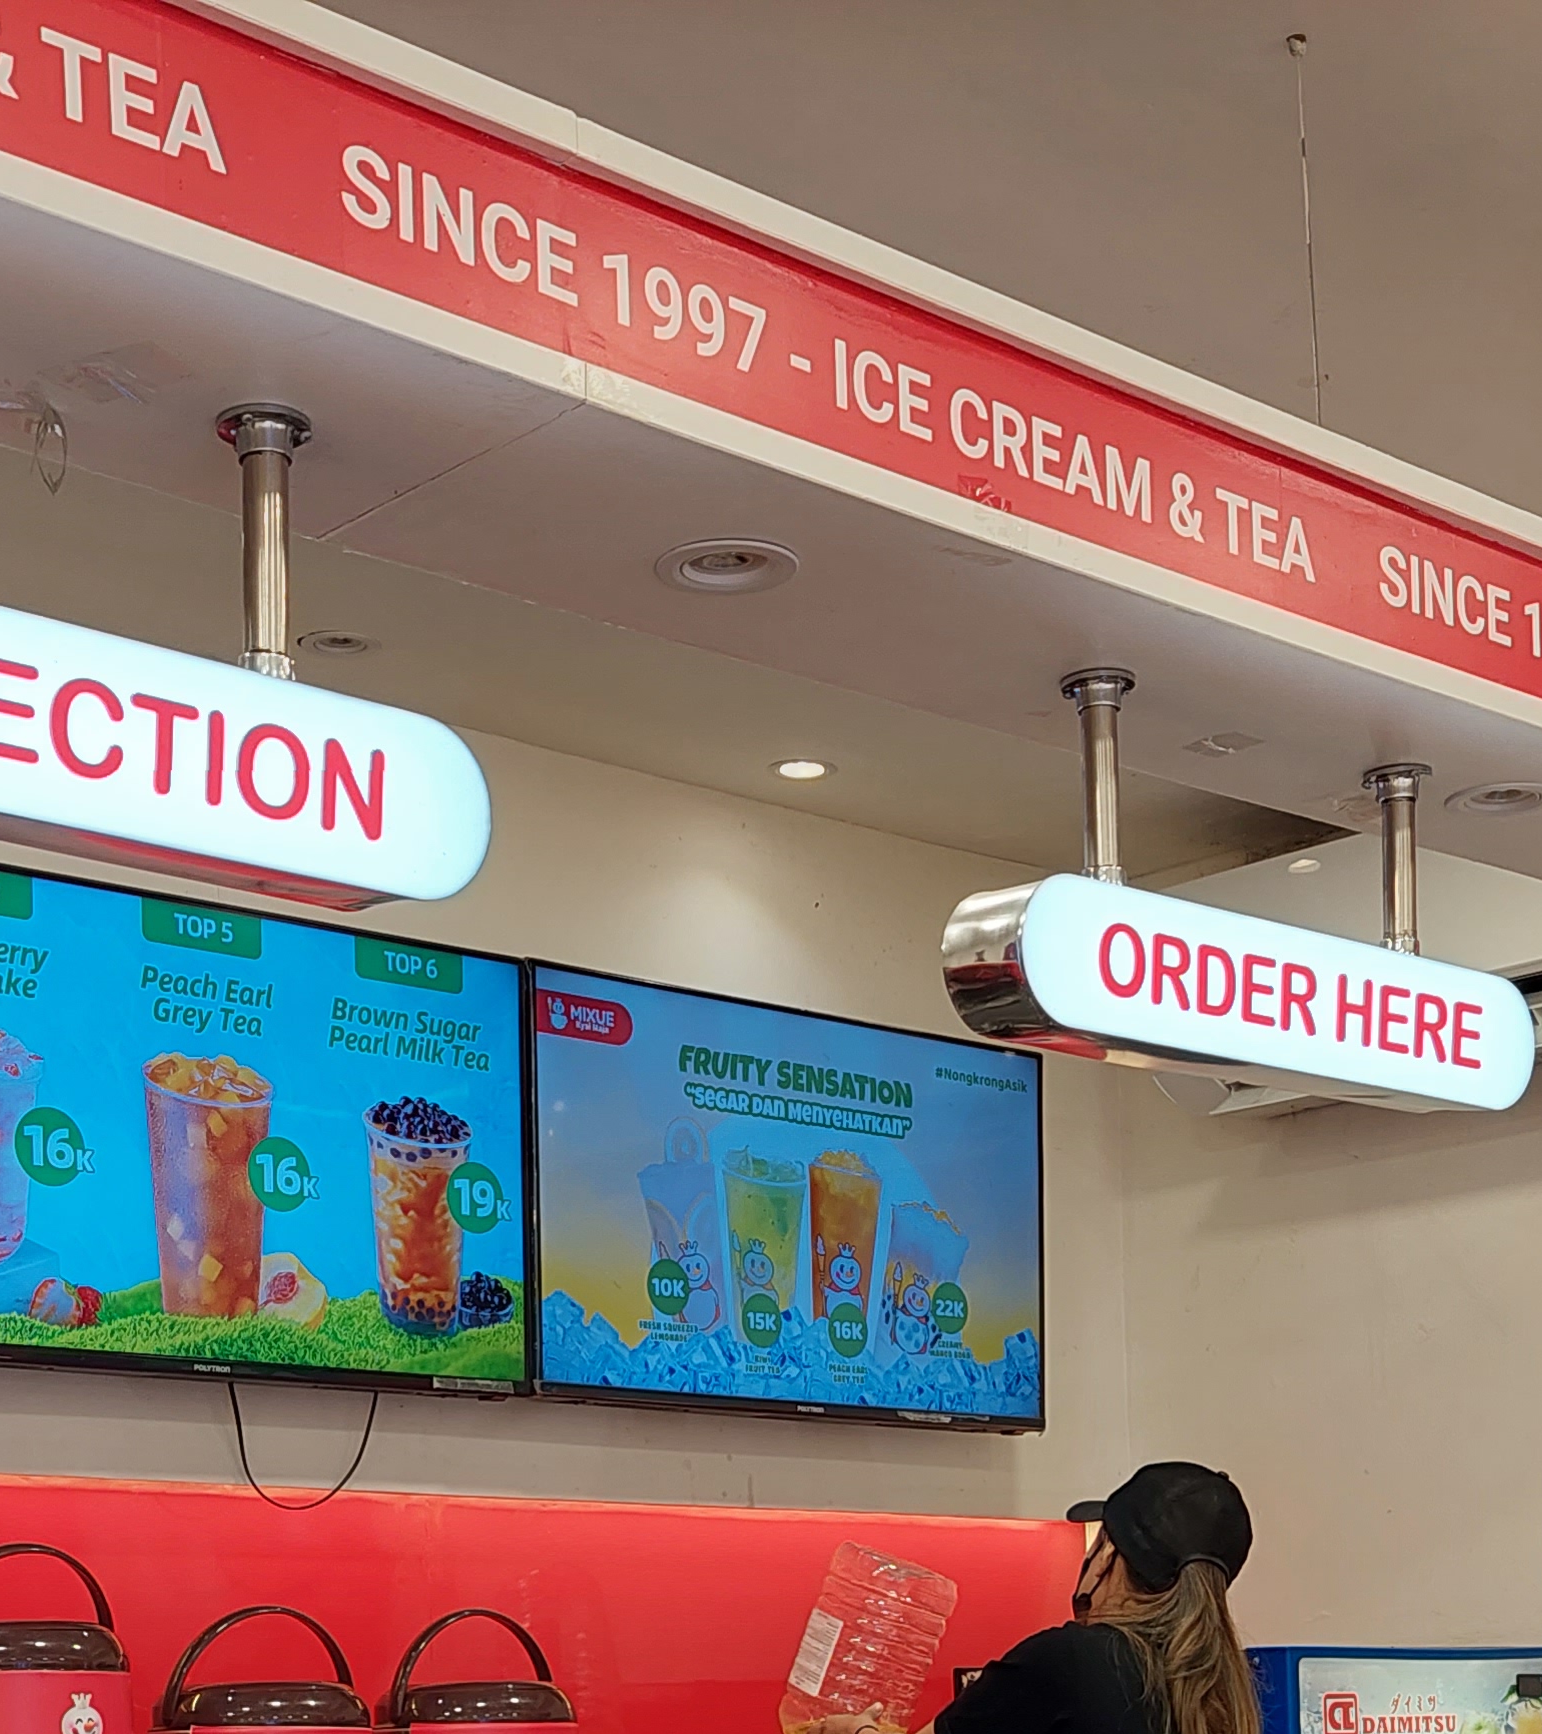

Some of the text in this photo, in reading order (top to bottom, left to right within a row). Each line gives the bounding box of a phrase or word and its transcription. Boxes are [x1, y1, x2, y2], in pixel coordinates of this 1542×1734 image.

[40, 24, 227, 176] TEA
[340, 142, 1317, 585] SINCE 1997 ICE CREAM & TEA
[1378, 544, 1513, 646] SINCE
[173, 912, 234, 944] TOP 5
[384, 950, 439, 979] TOP 6
[140, 964, 273, 1011] Peach Earl
[1099, 924, 1483, 1072] ORDER HERE
[152, 998, 263, 1037] Grey Tea
[330, 996, 482, 1046] Brown Sugar
[570, 1003, 615, 1027] MIXUE
[328, 1024, 491, 1073] Pearl Milk Tea
[679, 1044, 913, 1108] FRUITY SENSATION
[935, 1067, 1028, 1093] #NongkrongAsik
[652, 1277, 685, 1298] 10K
[746, 1311, 777, 1332] 15K
[936, 1299, 964, 1318] 22K
[833, 1321, 863, 1341] 16K
[1362, 1715, 1456, 1734] DAIMITSU
